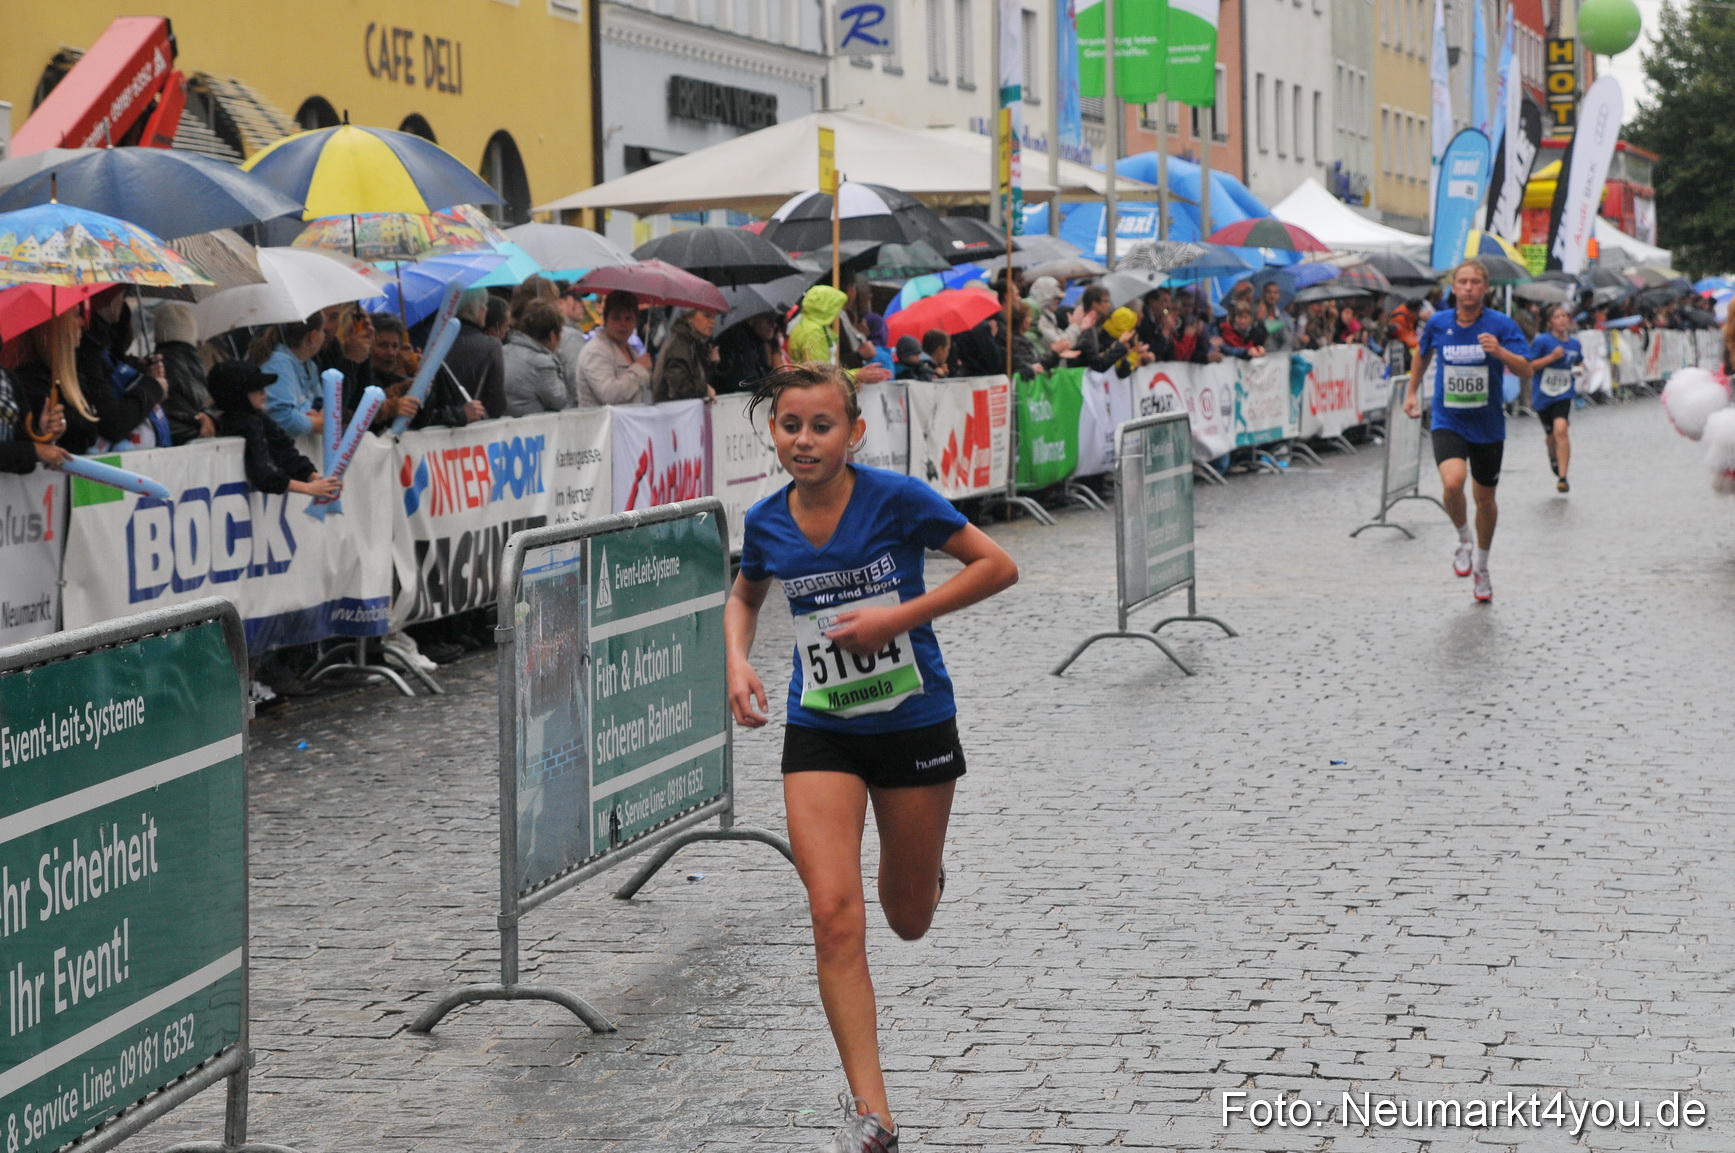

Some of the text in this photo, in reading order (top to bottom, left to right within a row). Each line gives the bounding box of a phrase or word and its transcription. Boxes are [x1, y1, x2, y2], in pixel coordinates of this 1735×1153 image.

[364, 22, 462, 95] CAFE DELI
[1548, 39, 1576, 140] HOT
[332, 381, 342, 452] ReiseCenter
[1447, 377, 1484, 393] 5068
[341, 398, 380, 462] ReiseCenter
[426, 434, 546, 518] INTERSPORT
[0, 484, 56, 548] lus1
[125, 480, 297, 605] BOCK
[615, 554, 680, 590] Event-Leit-Systeme
[784, 554, 897, 599] SPORTWEISS
[814, 592, 835, 606] Wir
[837, 588, 862, 600] sind
[3, 592, 52, 630] Neumarkt
[596, 633, 683, 700] Fun & Action in
[828, 680, 894, 710] Manuela
[1, 695, 145, 769] Event-Leit-Systeme
[596, 689, 692, 766] sicheren Bahnen!
[915, 750, 954, 770] hummel
[617, 803, 624, 830] &
[625, 793, 649, 827] Service
[650, 786, 666, 815] Line:
[667, 774, 686, 806] 09181
[687, 766, 704, 796] 6352
[0, 811, 158, 938] hr Sicherheit
[9, 916, 129, 1037] Ihr Event!
[7, 1012, 195, 1153] & Service Line: 09181 6352
